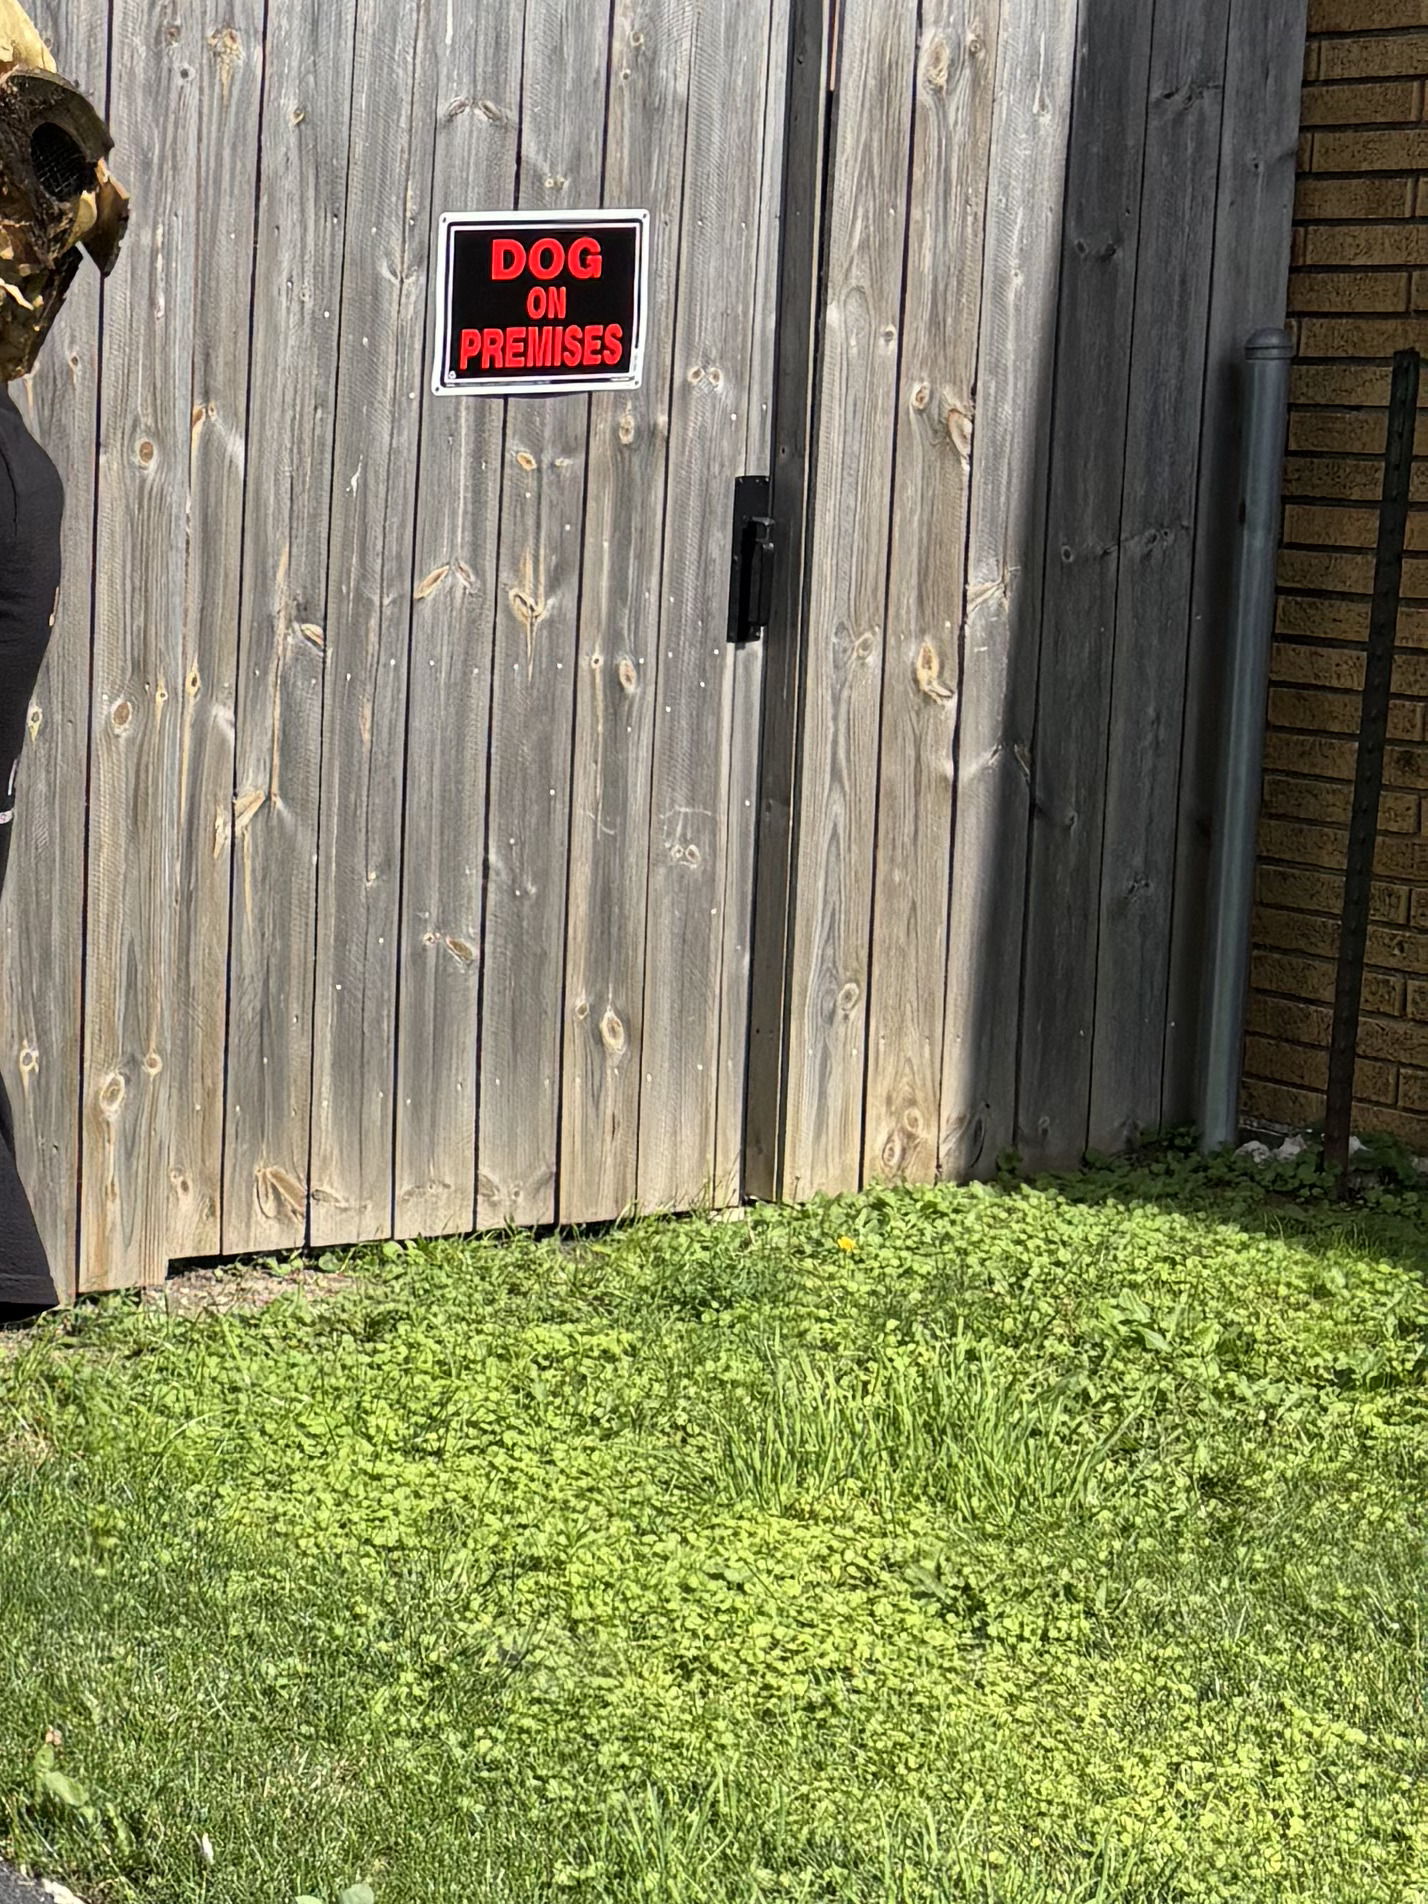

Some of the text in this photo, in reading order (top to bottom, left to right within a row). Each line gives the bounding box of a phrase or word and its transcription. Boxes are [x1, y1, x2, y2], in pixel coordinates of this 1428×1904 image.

[491, 237, 603, 280] DOG
[526, 286, 567, 319] ON
[459, 323, 623, 370] PREMISES
